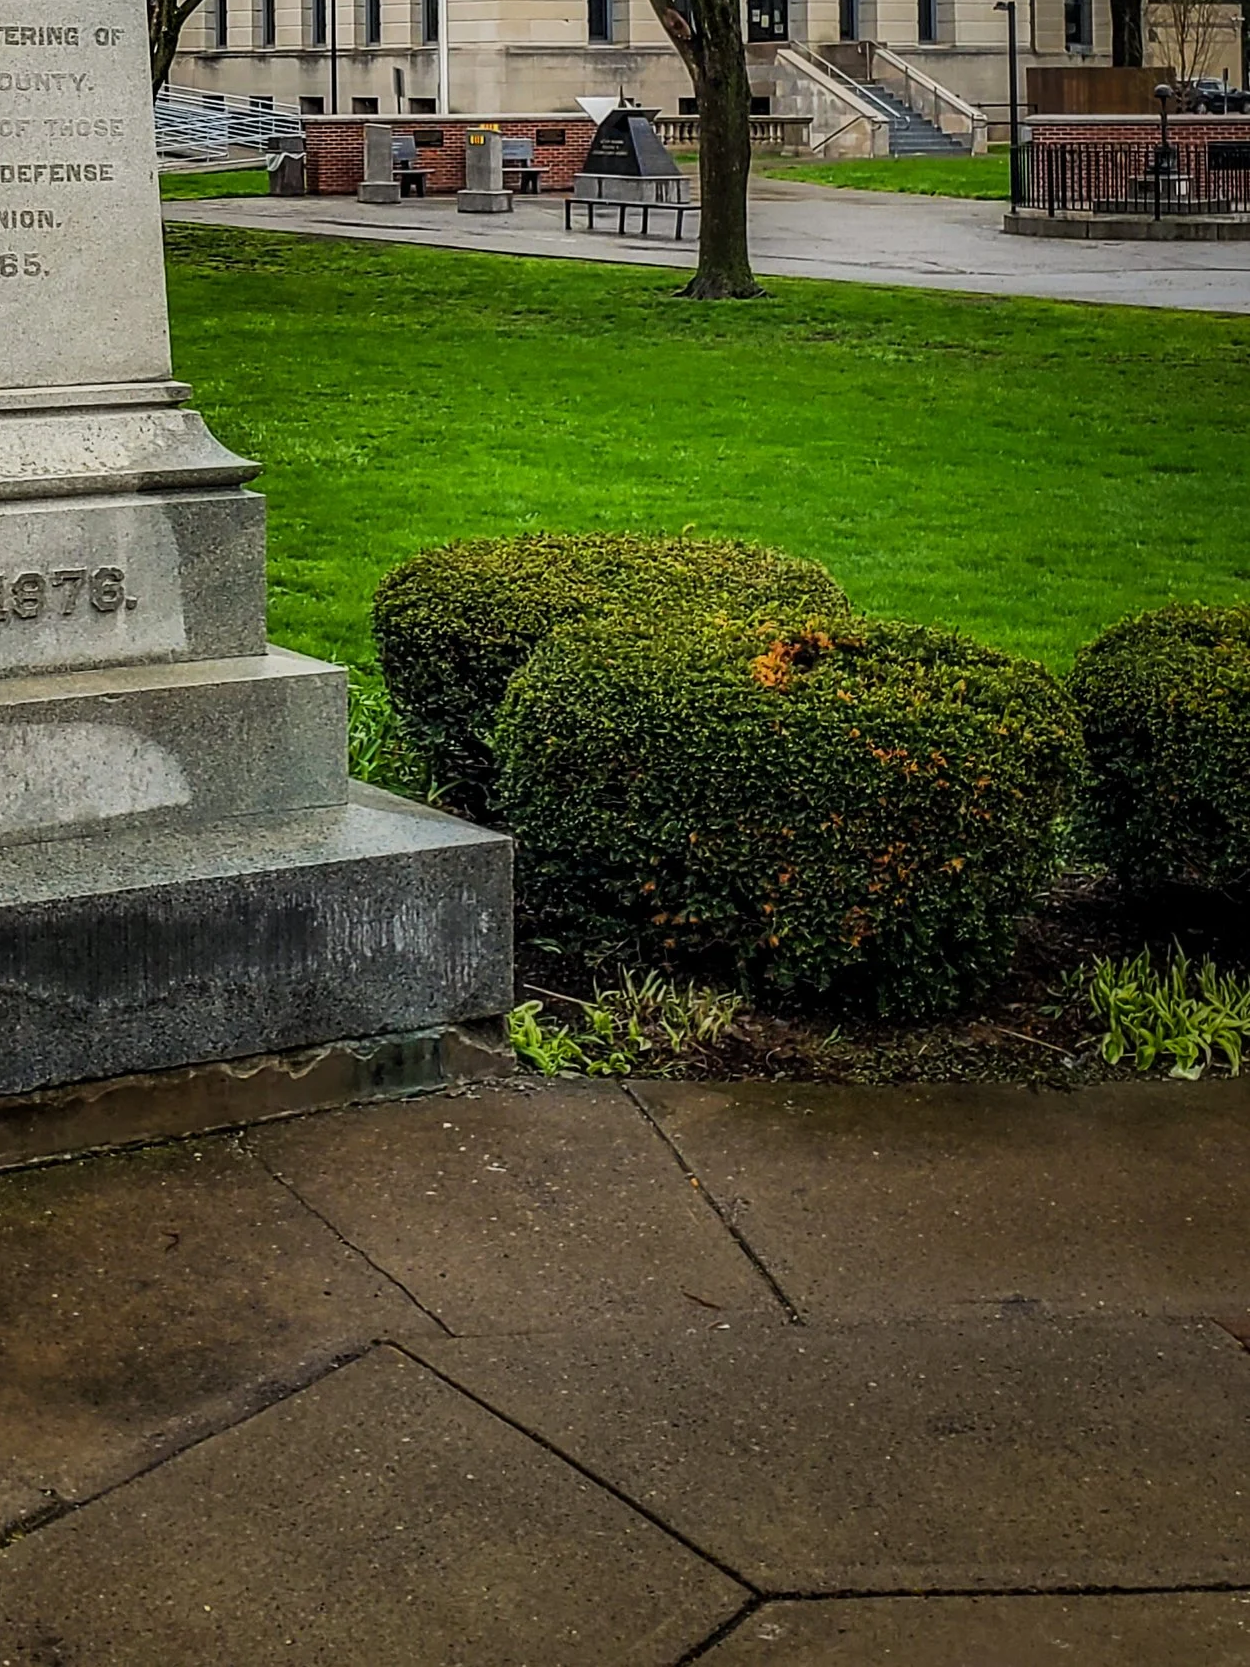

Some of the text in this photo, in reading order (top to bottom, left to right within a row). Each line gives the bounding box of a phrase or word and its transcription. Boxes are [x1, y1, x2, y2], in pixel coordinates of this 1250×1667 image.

[95, 26, 125, 46] OF
[0, 118, 30, 137] OF
[44, 117, 124, 137] THOSE
[0, 163, 114, 184] DEFENSE
